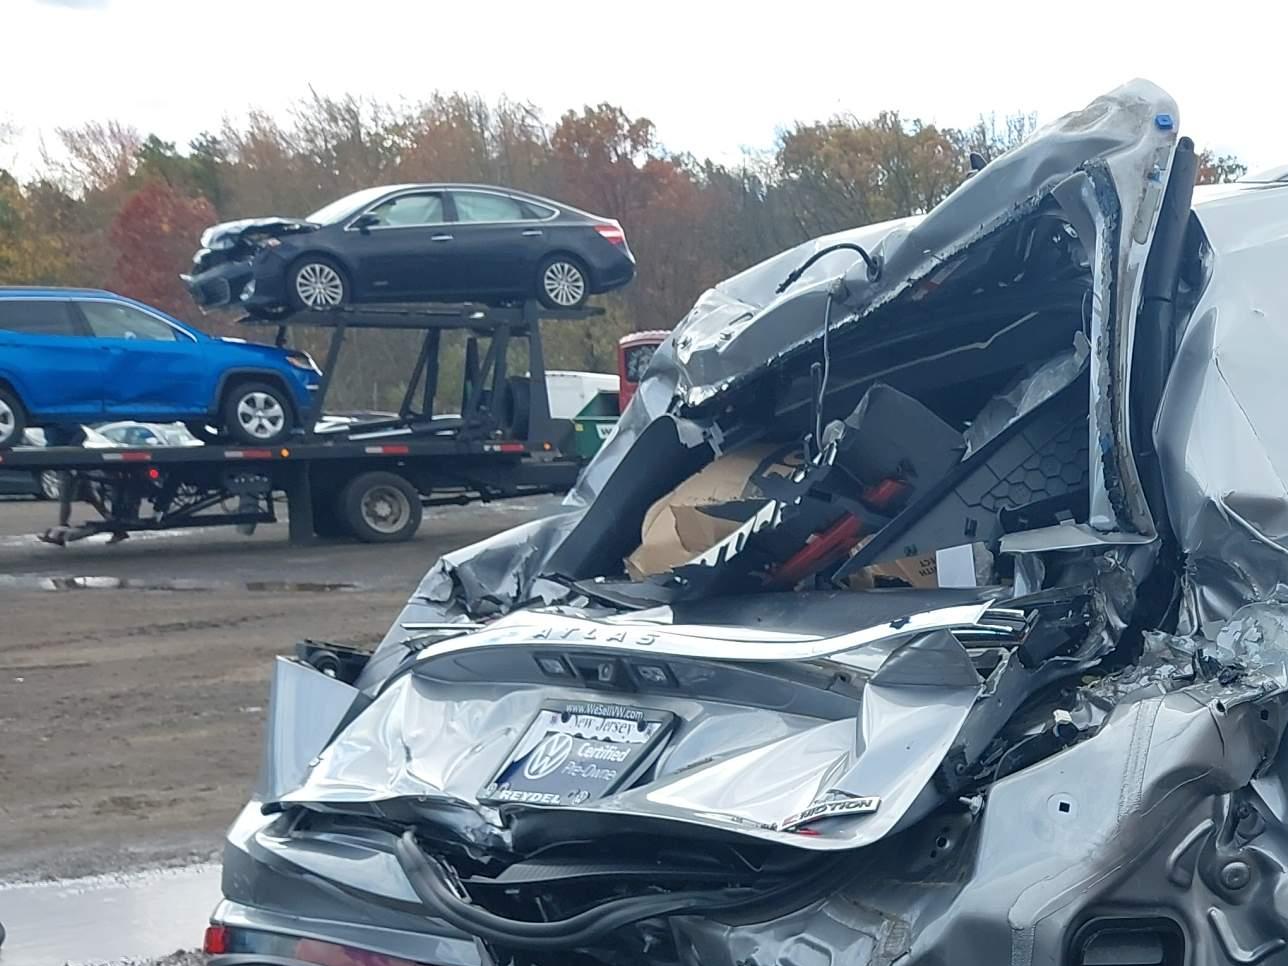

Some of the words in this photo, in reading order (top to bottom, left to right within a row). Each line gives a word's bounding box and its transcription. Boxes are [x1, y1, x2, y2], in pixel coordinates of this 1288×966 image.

[533, 627, 661, 646] ATLAS
[596, 717, 635, 735] Jersey
[577, 742, 632, 763] Certified
[561, 761, 617, 781] Pre-Owne
[499, 788, 561, 804] REYDEL
